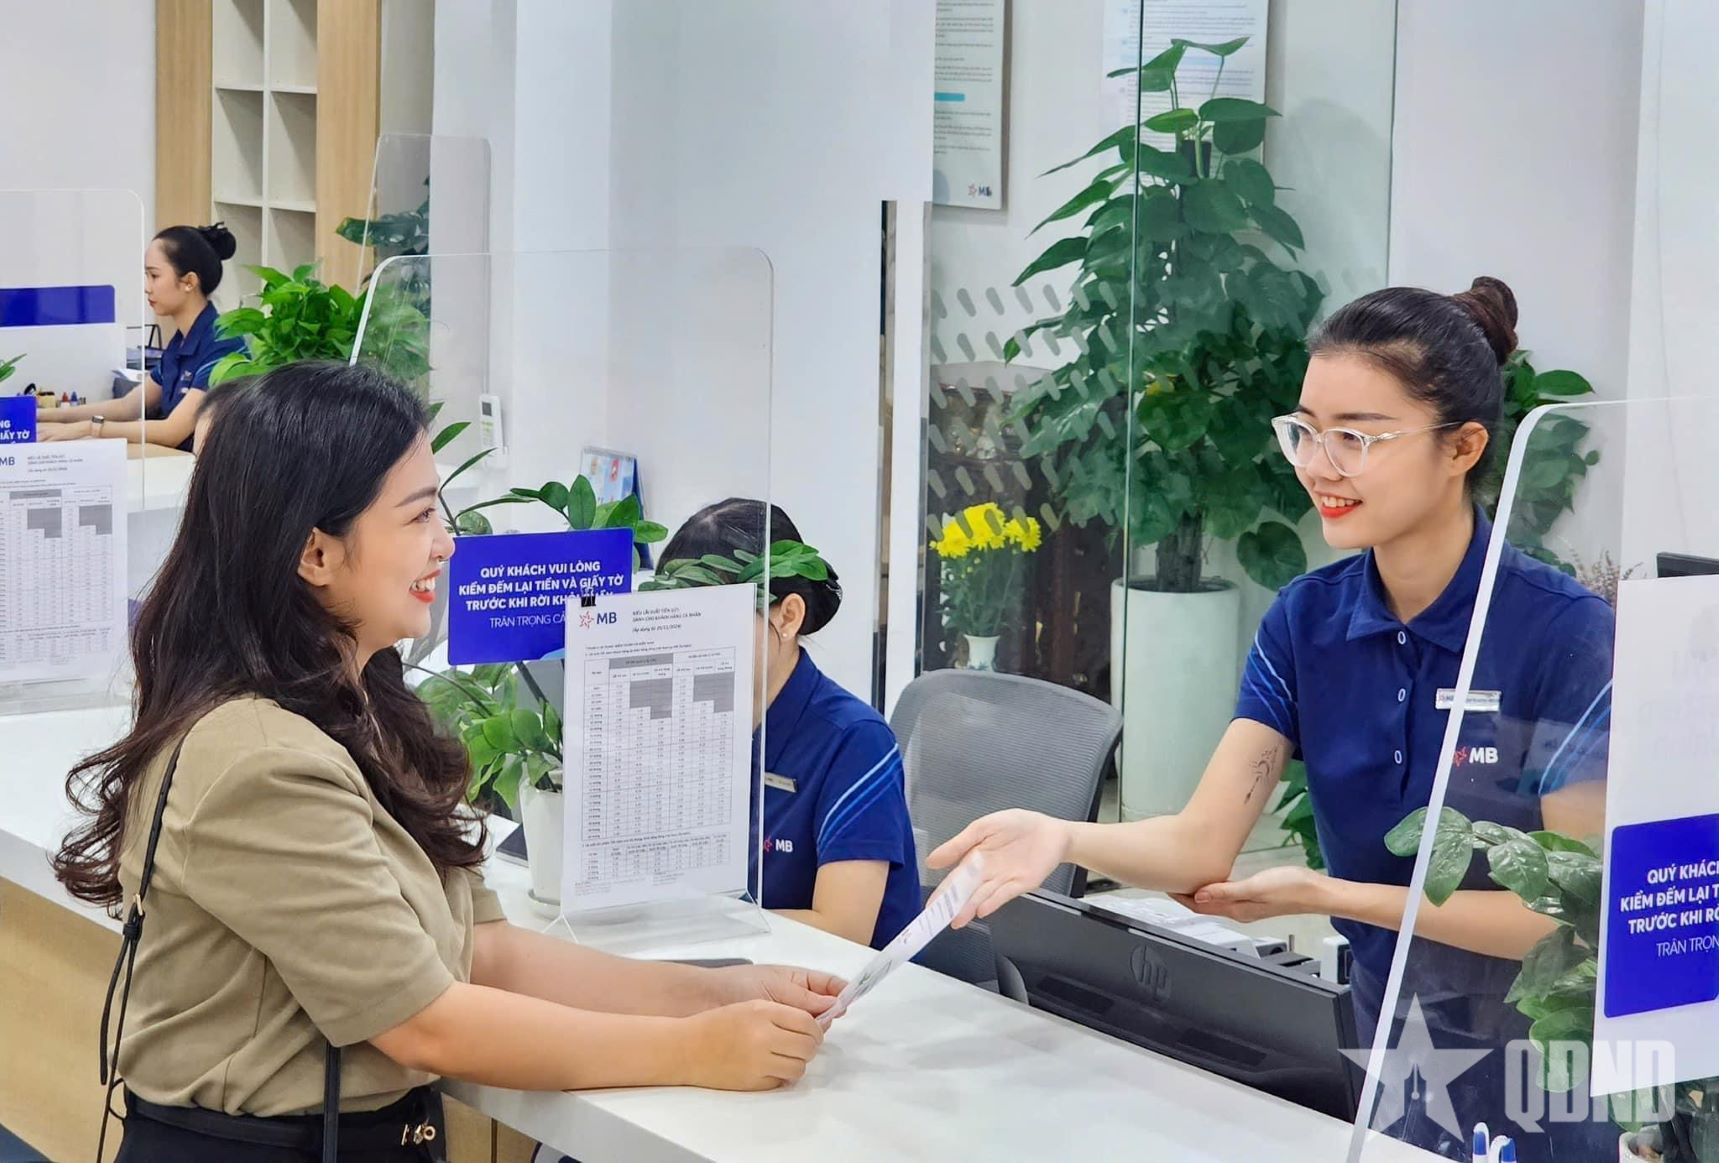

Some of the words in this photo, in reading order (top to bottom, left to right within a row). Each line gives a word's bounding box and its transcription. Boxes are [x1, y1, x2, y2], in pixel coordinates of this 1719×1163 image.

[0, 420, 11, 429] NG
[480, 564, 504, 579] QUÝ
[507, 562, 545, 577] KHÁCH
[549, 563, 567, 575] VUI
[570, 559, 600, 573] LÒNG
[488, 578, 513, 594] ĐẾM
[515, 581, 533, 596] LẠI
[563, 576, 578, 589] VÀ
[608, 574, 624, 586] TỜ
[466, 595, 507, 611] TRƯỚC
[509, 595, 528, 608] KHI
[530, 593, 550, 607] RỜI
[489, 614, 516, 629] TRÂN
[517, 613, 551, 628] TRỌNG
[596, 612, 617, 625] MB
[1469, 747, 1499, 764] MB
[775, 839, 793, 853] MB
[1647, 863, 1677, 884] QUÝ
[1656, 885, 1686, 907] ĐẾM
[1688, 885, 1710, 904] LẠI
[1628, 911, 1678, 935] TRƯỚC
[1680, 909, 1703, 926] KHI
[1656, 937, 1687, 958] TRÂN
[1689, 934, 1719, 953] TRỌN
[1136, 944, 1169, 1000] hp
